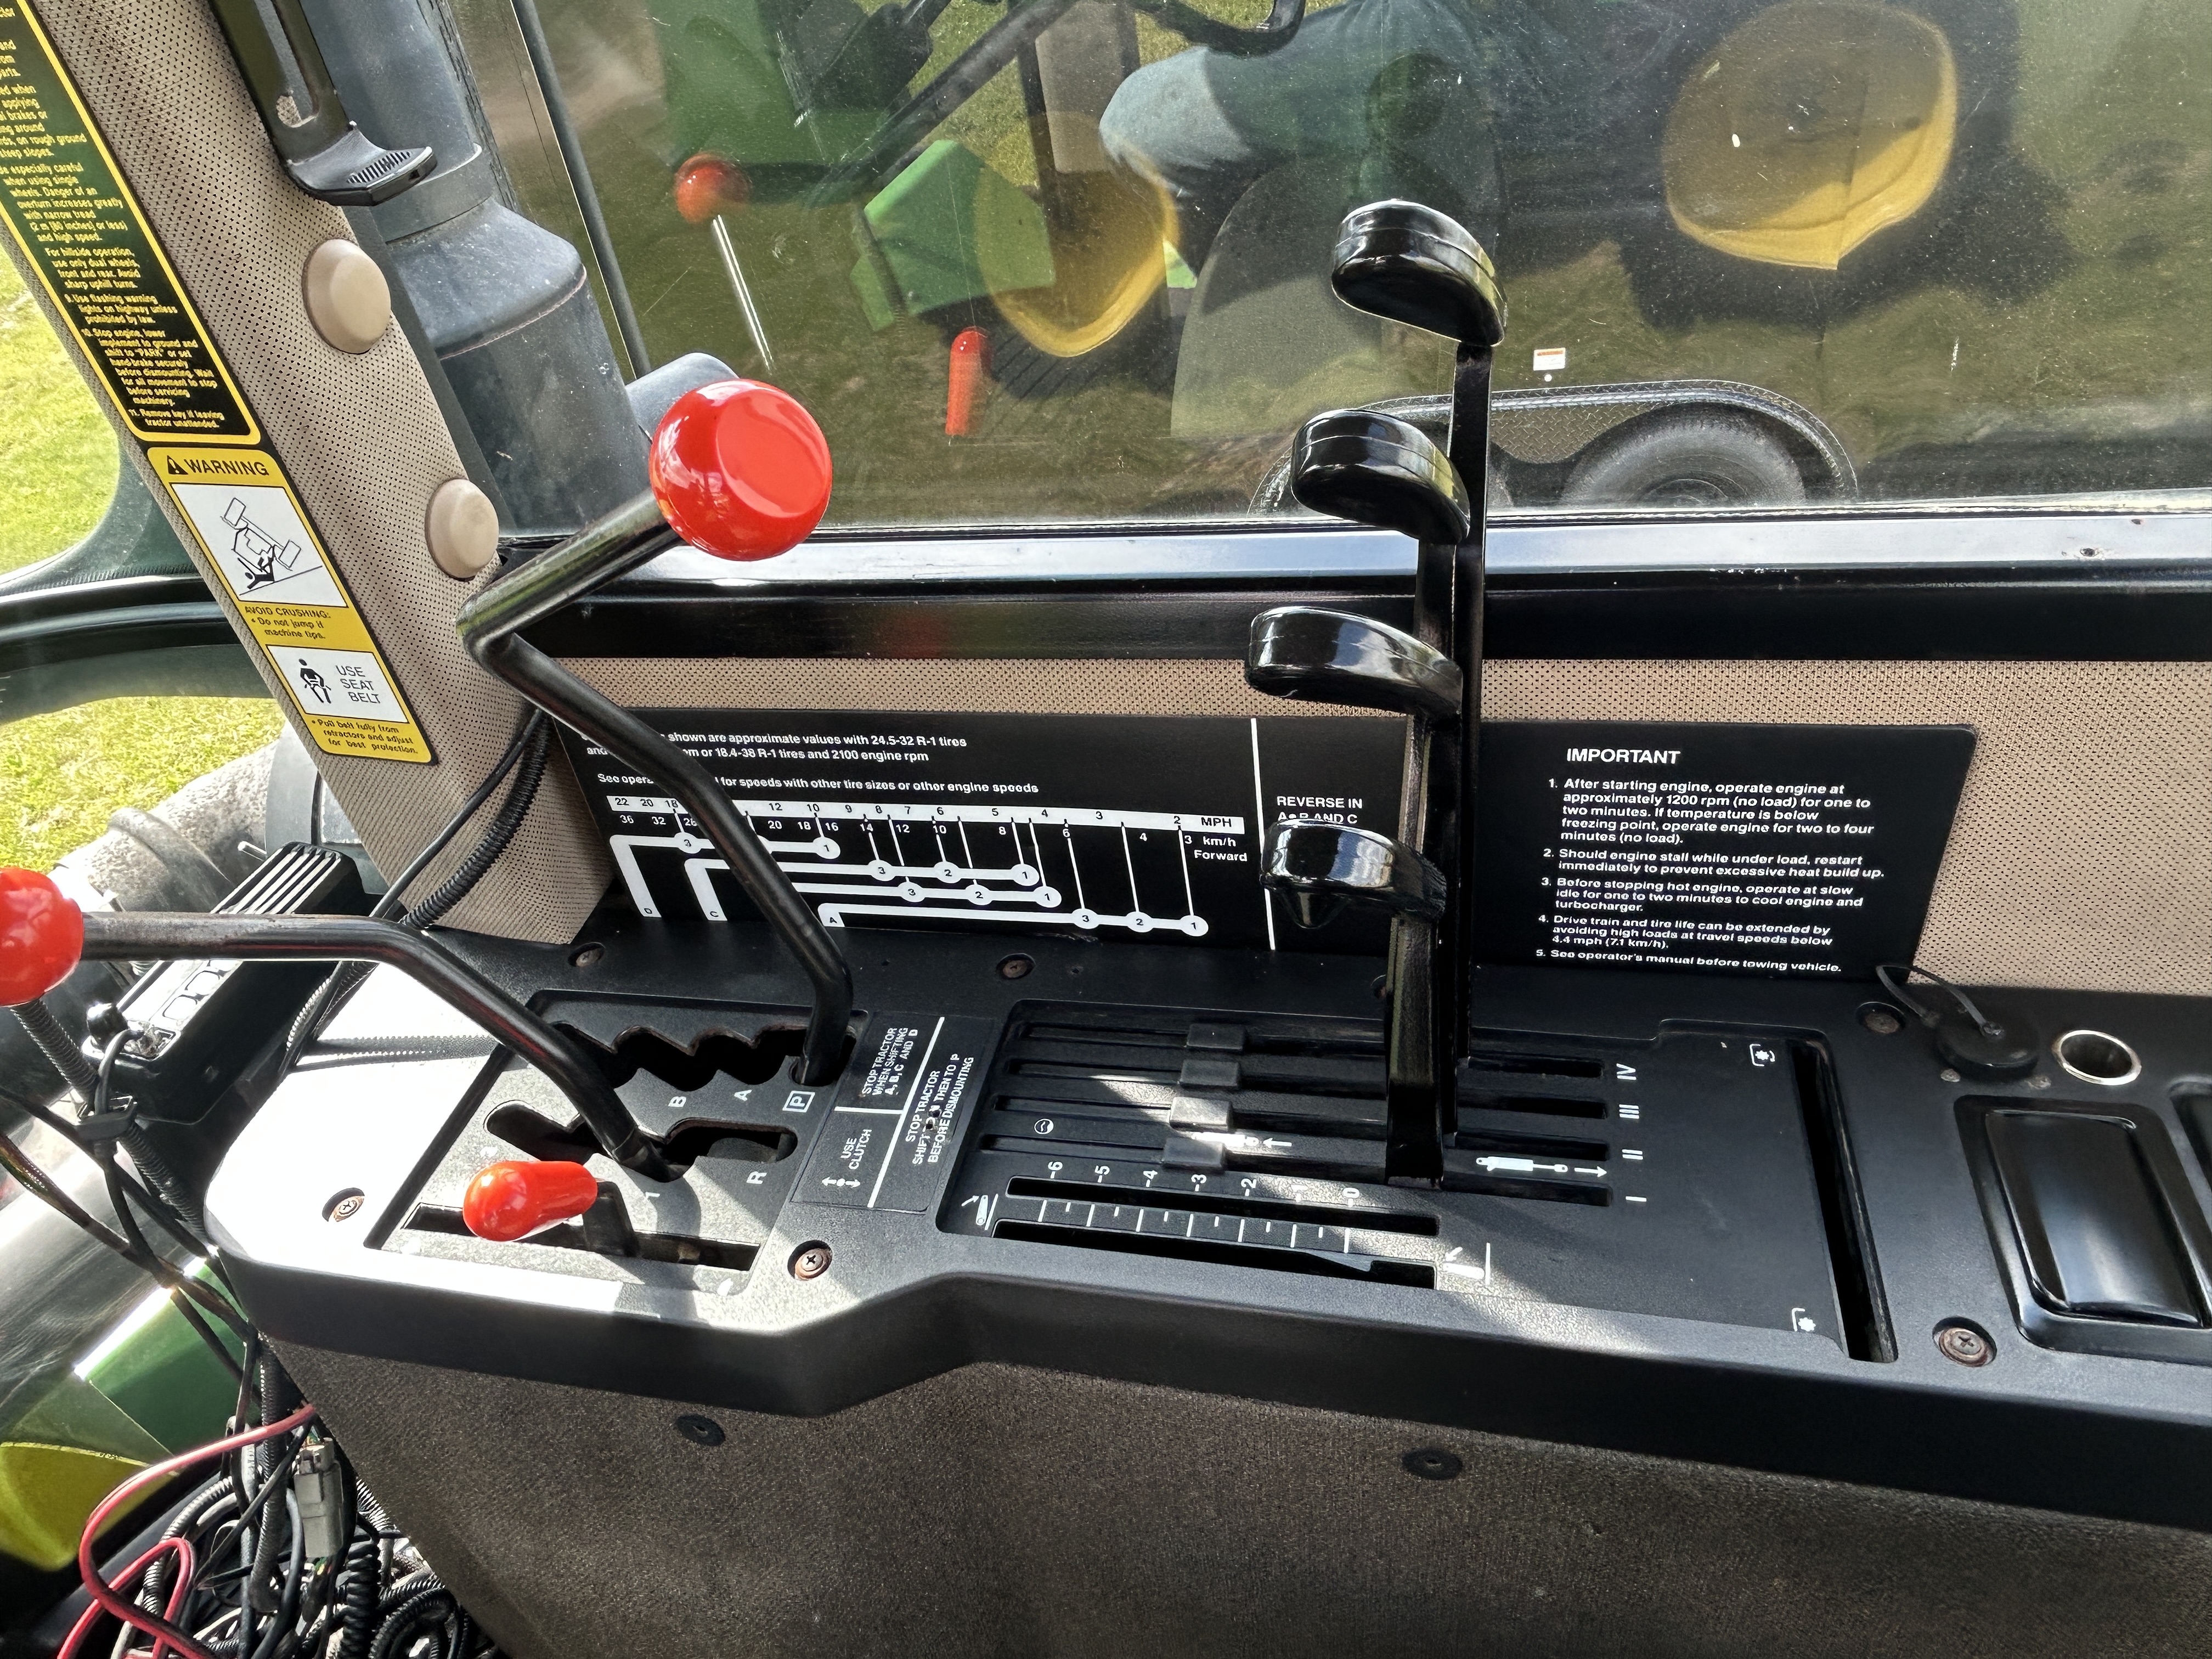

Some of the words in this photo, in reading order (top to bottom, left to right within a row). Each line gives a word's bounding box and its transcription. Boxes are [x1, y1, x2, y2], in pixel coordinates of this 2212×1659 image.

[184, 459, 269, 476] WARNING
[245, 606, 273, 615] AVOID
[264, 629, 303, 637] machine
[335, 665, 365, 677] USE
[340, 679, 374, 691] SEAT
[348, 692, 380, 704] BELT
[378, 725, 399, 733] from
[668, 732, 707, 742] shown
[708, 734, 727, 742] are
[729, 733, 801, 745] approximate
[802, 734, 842, 744] values
[843, 735, 870, 745] with
[871, 735, 915, 746] 24.5-32
[916, 736, 936, 746] R-1
[939, 736, 967, 747] tires
[701, 749, 713, 757] or
[715, 747, 756, 758] 18.4-38
[757, 748, 777, 758] R-1
[778, 748, 806, 759] tires
[807, 749, 830, 759] and
[831, 749, 859, 760] 2100
[861, 750, 902, 763] engine
[904, 753, 929, 763] rpm
[1567, 748, 1681, 764] IMPORTANT
[597, 774, 620, 783] See
[720, 776, 737, 786] for
[739, 777, 782, 788] speeds
[782, 778, 809, 788] with
[810, 779, 842, 789] other
[843, 779, 863, 789] tire
[865, 780, 896, 790] sizes
[898, 782, 911, 791] or
[913, 781, 945, 791] other
[947, 782, 989, 794] engine
[992, 783, 1039, 794] speeds
[1548, 778, 1558, 788] 1.
[1564, 778, 1600, 789] After
[1602, 780, 1657, 793] starting
[1660, 781, 1713, 793] engine,
[1715, 783, 1773, 794] operate
[1775, 783, 1827, 795] engine
[1829, 785, 1845, 794] at
[1277, 795, 1345, 808] REVERSE
[1348, 798, 1363, 809] IN
[1563, 793, 1663, 806] approximately
[1666, 794, 1698, 805] 1200
[1701, 797, 1730, 808] rpm
[1733, 795, 1758, 808] (no
[1760, 797, 1797, 809] load)
[1800, 797, 1822, 807] for
[1824, 799, 1853, 808] one
[1855, 798, 1871, 808] to
[769, 803, 782, 811] 12
[845, 805, 852, 813] 9
[875, 805, 882, 814] 8
[905, 806, 911, 814] 7
[937, 807, 944, 815] 6
[1096, 811, 1103, 820] 3
[1174, 816, 1181, 824] 2
[1201, 817, 1232, 827] MPH
[1347, 814, 1358, 824] C
[1562, 805, 1588, 815] two
[1590, 805, 1652, 817] minutes.
[1655, 807, 1664, 817] If
[1667, 808, 1756, 820] temperature
[1758, 810, 1771, 820] is
[1774, 810, 1819, 820] below
[652, 816, 666, 825] 32
[768, 820, 782, 829] 20
[798, 821, 811, 830] 18
[825, 822, 838, 831] 16
[896, 824, 910, 833] 12
[933, 825, 946, 834] 10
[999, 826, 1006, 835] 8
[1063, 828, 1070, 837] 6
[1203, 836, 1236, 847] km/h
[1561, 817, 1617, 831] freezing
[1620, 820, 1660, 831] point,
[1662, 822, 1718, 833] operate
[1720, 822, 1770, 834] engine
[1773, 822, 1793, 833] for
[1796, 823, 1823, 833] two
[1826, 824, 1841, 834] to
[1843, 823, 1875, 834] four
[1560, 831, 1616, 842] minutes
[1619, 832, 1643, 844] (no
[1645, 833, 1684, 845] load).
[1194, 849, 1248, 862] Forward
[862, 1069, 878, 1094] STOP
[872, 1028, 897, 1068] TRACTOR
[872, 1068, 891, 1096] WHEN
[885, 1028, 908, 1067] SHIFTING
[1616, 1063, 1637, 1080] IV
[668, 1096, 686, 1108] B
[734, 1090, 752, 1102] A
[789, 1096, 806, 1107] P
[905, 1114, 922, 1142] STOP
[915, 1070, 940, 1113] TRACTOR
[928, 1119, 950, 1163] BEFORE
[941, 1057, 974, 1119] DISMOUNTING
[1619, 1104, 1639, 1119] III
[912, 1133, 930, 1165] SHIFT
[933, 1077, 952, 1102] THEN
[944, 1064, 956, 1076] TO
[840, 1137, 857, 1159] USE
[849, 1129, 872, 1170] CLUTCH
[746, 1171, 768, 1184] R
[1048, 1161, 1063, 1171] 6
[1094, 1165, 1110, 1175] 5
[1143, 1170, 1158, 1179] 4
[1191, 1174, 1207, 1184] 3
[1241, 1178, 1257, 1189] 2
